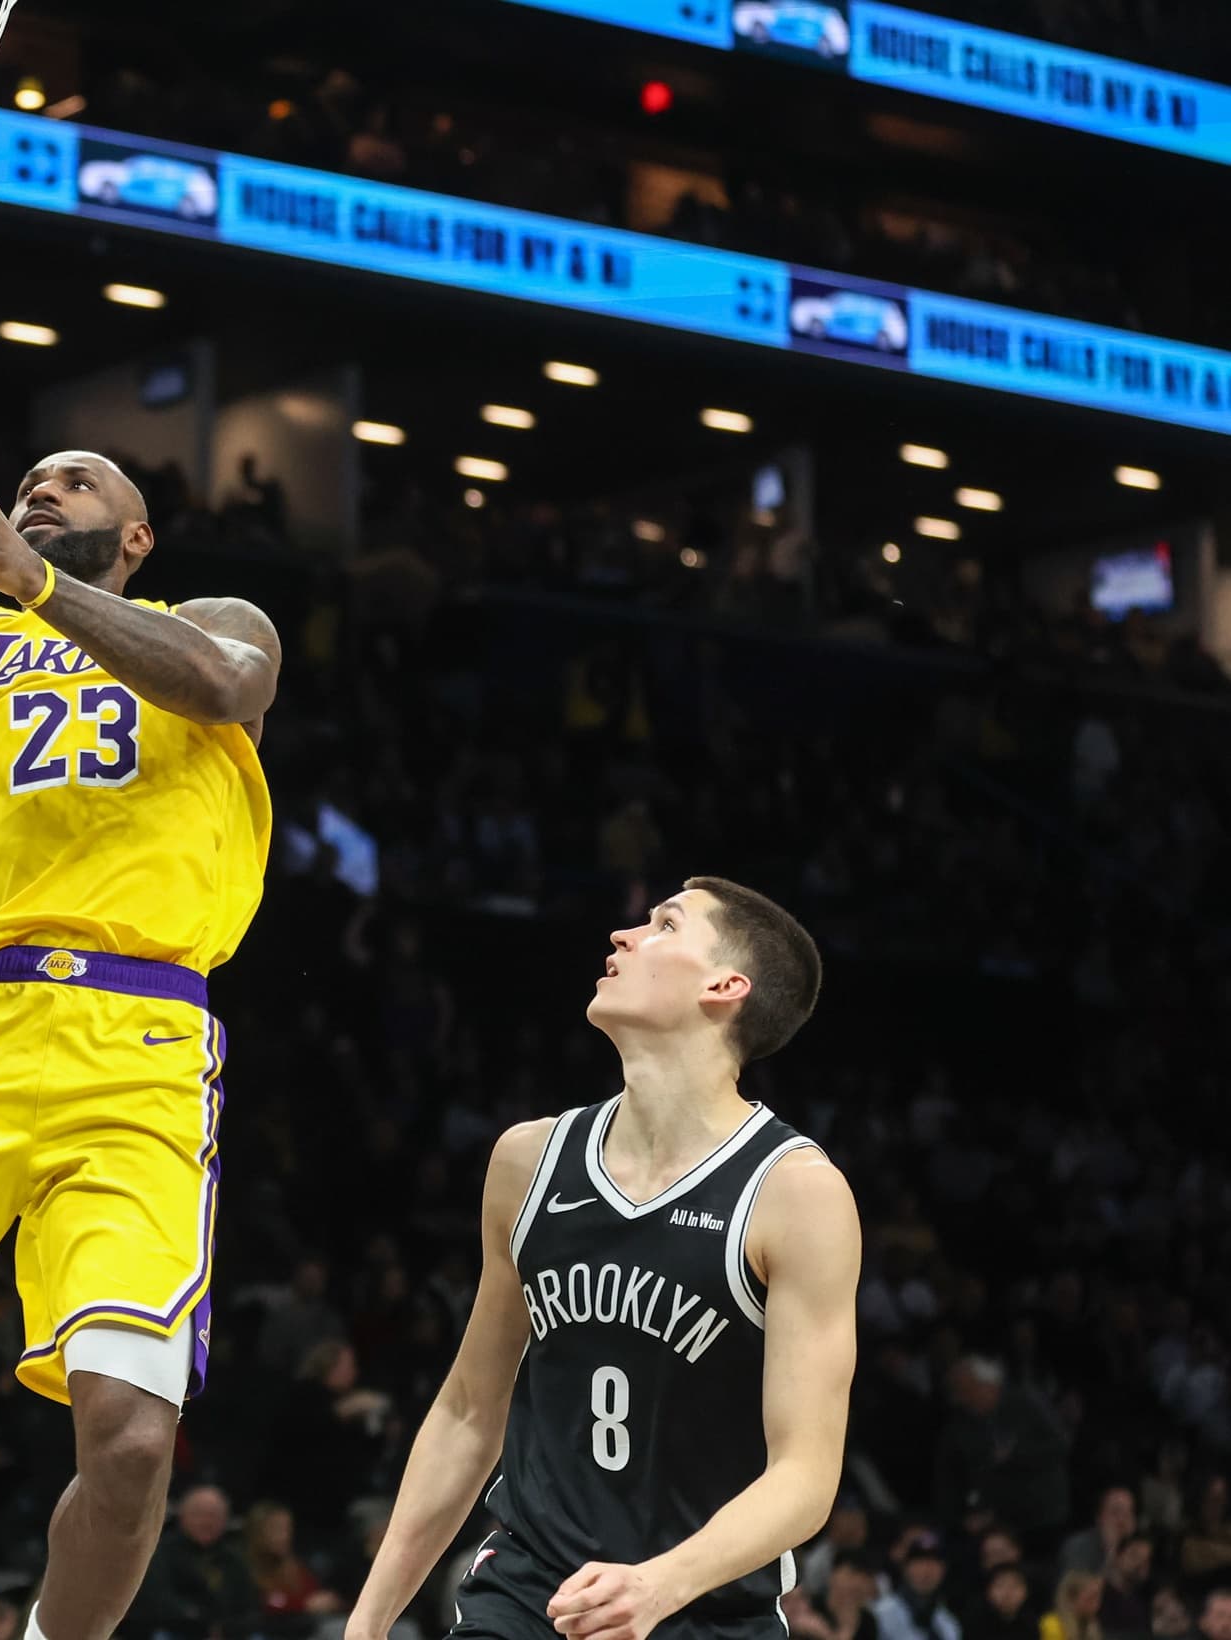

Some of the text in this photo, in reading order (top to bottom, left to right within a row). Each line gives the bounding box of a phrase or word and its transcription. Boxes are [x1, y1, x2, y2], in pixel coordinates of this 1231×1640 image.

[10, 685, 139, 795] 23
[36, 954, 87, 976] LAKERS
[669, 1208, 725, 1231] All In Won
[522, 1263, 730, 1364] BROOKLYN
[591, 1366, 631, 1471] 8
